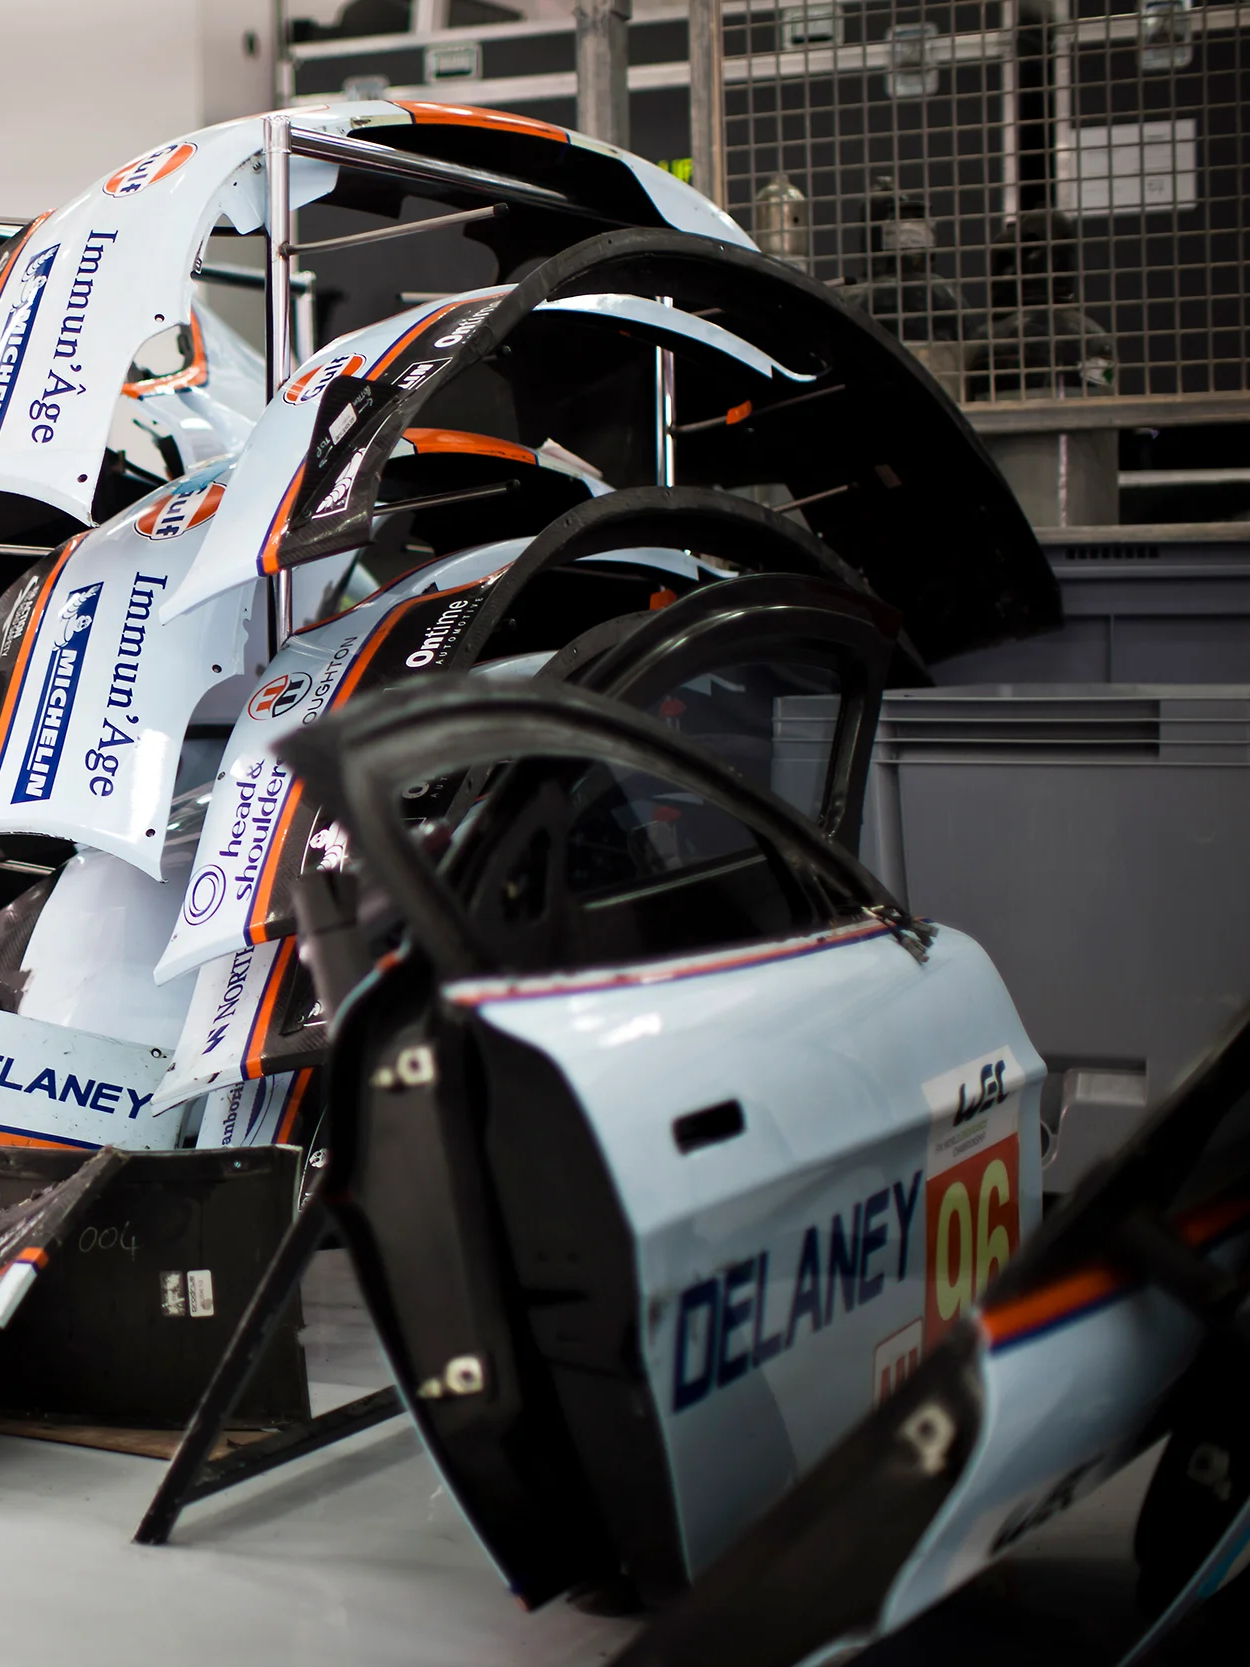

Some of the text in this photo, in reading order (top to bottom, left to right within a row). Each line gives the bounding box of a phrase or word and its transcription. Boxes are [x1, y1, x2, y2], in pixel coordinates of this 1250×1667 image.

[300, 355, 350, 402] Gulf
[405, 600, 469, 668] Ontime
[25, 649, 78, 798] MICHELIN
[301, 636, 358, 725] OUGHTON
[219, 758, 265, 858] head &
[78, 1220, 144, 1262] 004
[672, 1169, 924, 1413] DELANEY
